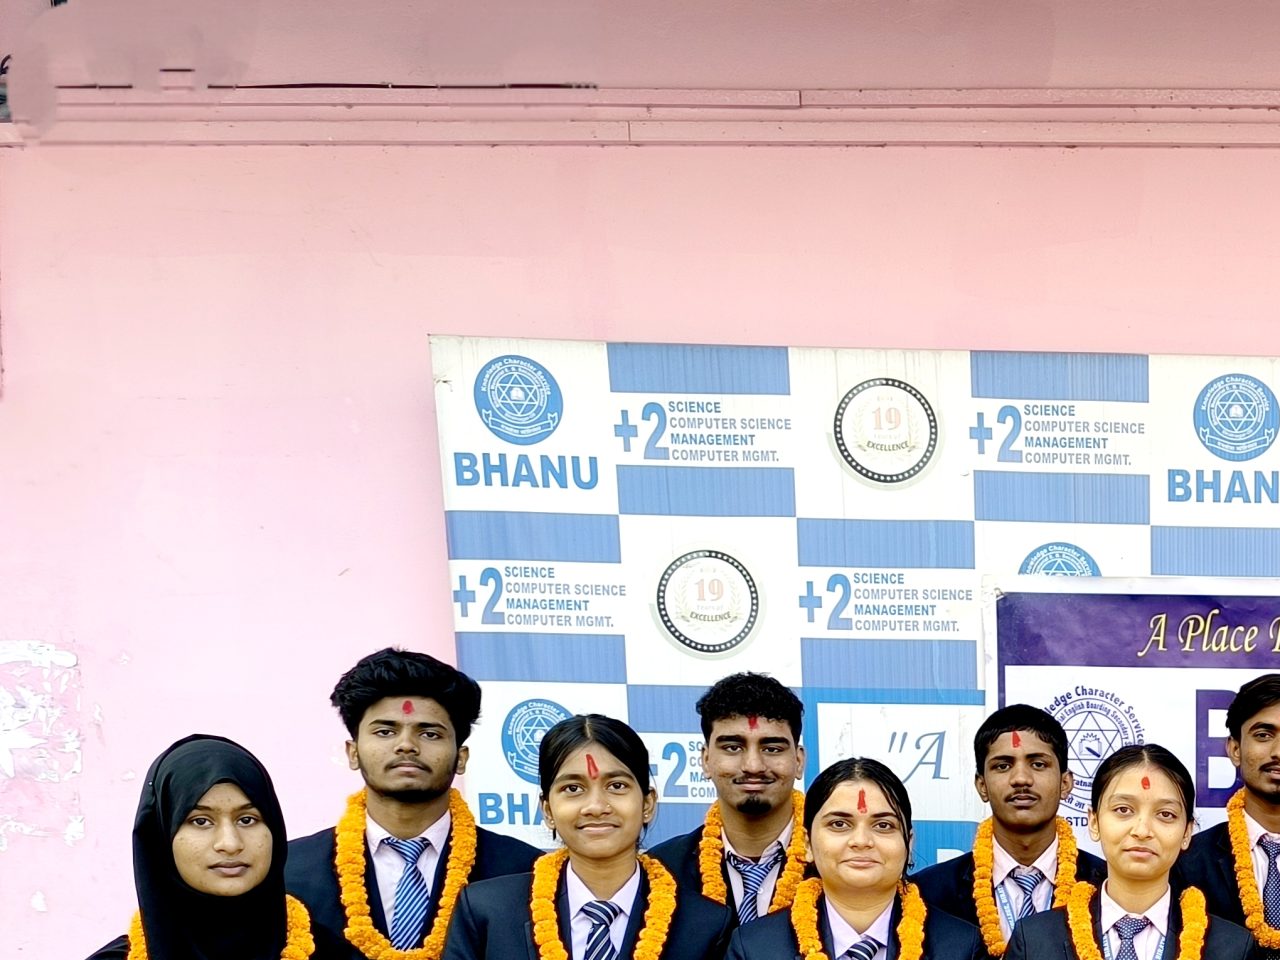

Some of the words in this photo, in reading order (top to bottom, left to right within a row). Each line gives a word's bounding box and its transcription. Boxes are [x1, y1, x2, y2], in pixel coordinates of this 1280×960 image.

[668, 401, 721, 413] SCIENCE
[1024, 405, 1075, 416] SCIENCE
[670, 417, 736, 429] COMPUTER
[741, 419, 791, 430] SCIENCE
[872, 407, 901, 430] 19
[614, 402, 669, 460] +2
[969, 405, 1023, 462] +2
[1024, 421, 1090, 433] COMPUTER
[1094, 422, 1145, 434] SCIENCE
[671, 434, 755, 445] MANAGEMENT
[867, 441, 909, 451] EXCELLENCE
[1024, 437, 1108, 449] MANAGEMENT
[672, 449, 739, 462] COMPUTER
[743, 451, 779, 462] MGMT.
[1025, 453, 1090, 464] COMPUTER
[1094, 454, 1131, 465] MGMT.
[454, 452, 598, 489] BHANU
[504, 566, 555, 578] SCIENCE
[853, 573, 904, 584] SCIENCE
[453, 567, 505, 624] +2
[506, 583, 570, 595] COMPUTER
[574, 584, 626, 596] SCIENCE
[695, 579, 724, 601] 19
[854, 589, 918, 600] COMPUTER
[923, 590, 972, 600] SCIENCE
[506, 599, 589, 611] MANAGEMENT
[799, 574, 852, 630] +2
[690, 611, 731, 622] EXCELLENCE
[855, 605, 936, 616] MANAGEMENT
[507, 614, 572, 626] COMPUTER
[576, 616, 614, 627] MGMT.
[855, 620, 919, 631] COMPUTER
[923, 621, 959, 632] MGMT.
[1138, 613, 1168, 656] A
[1179, 609, 1258, 652] Place
[1066, 703, 1085, 717] English
[1086, 701, 1111, 715] Boarding
[1111, 711, 1129, 740] Secondary
[1075, 685, 1124, 707] Character
[1124, 706, 1145, 745] Service
